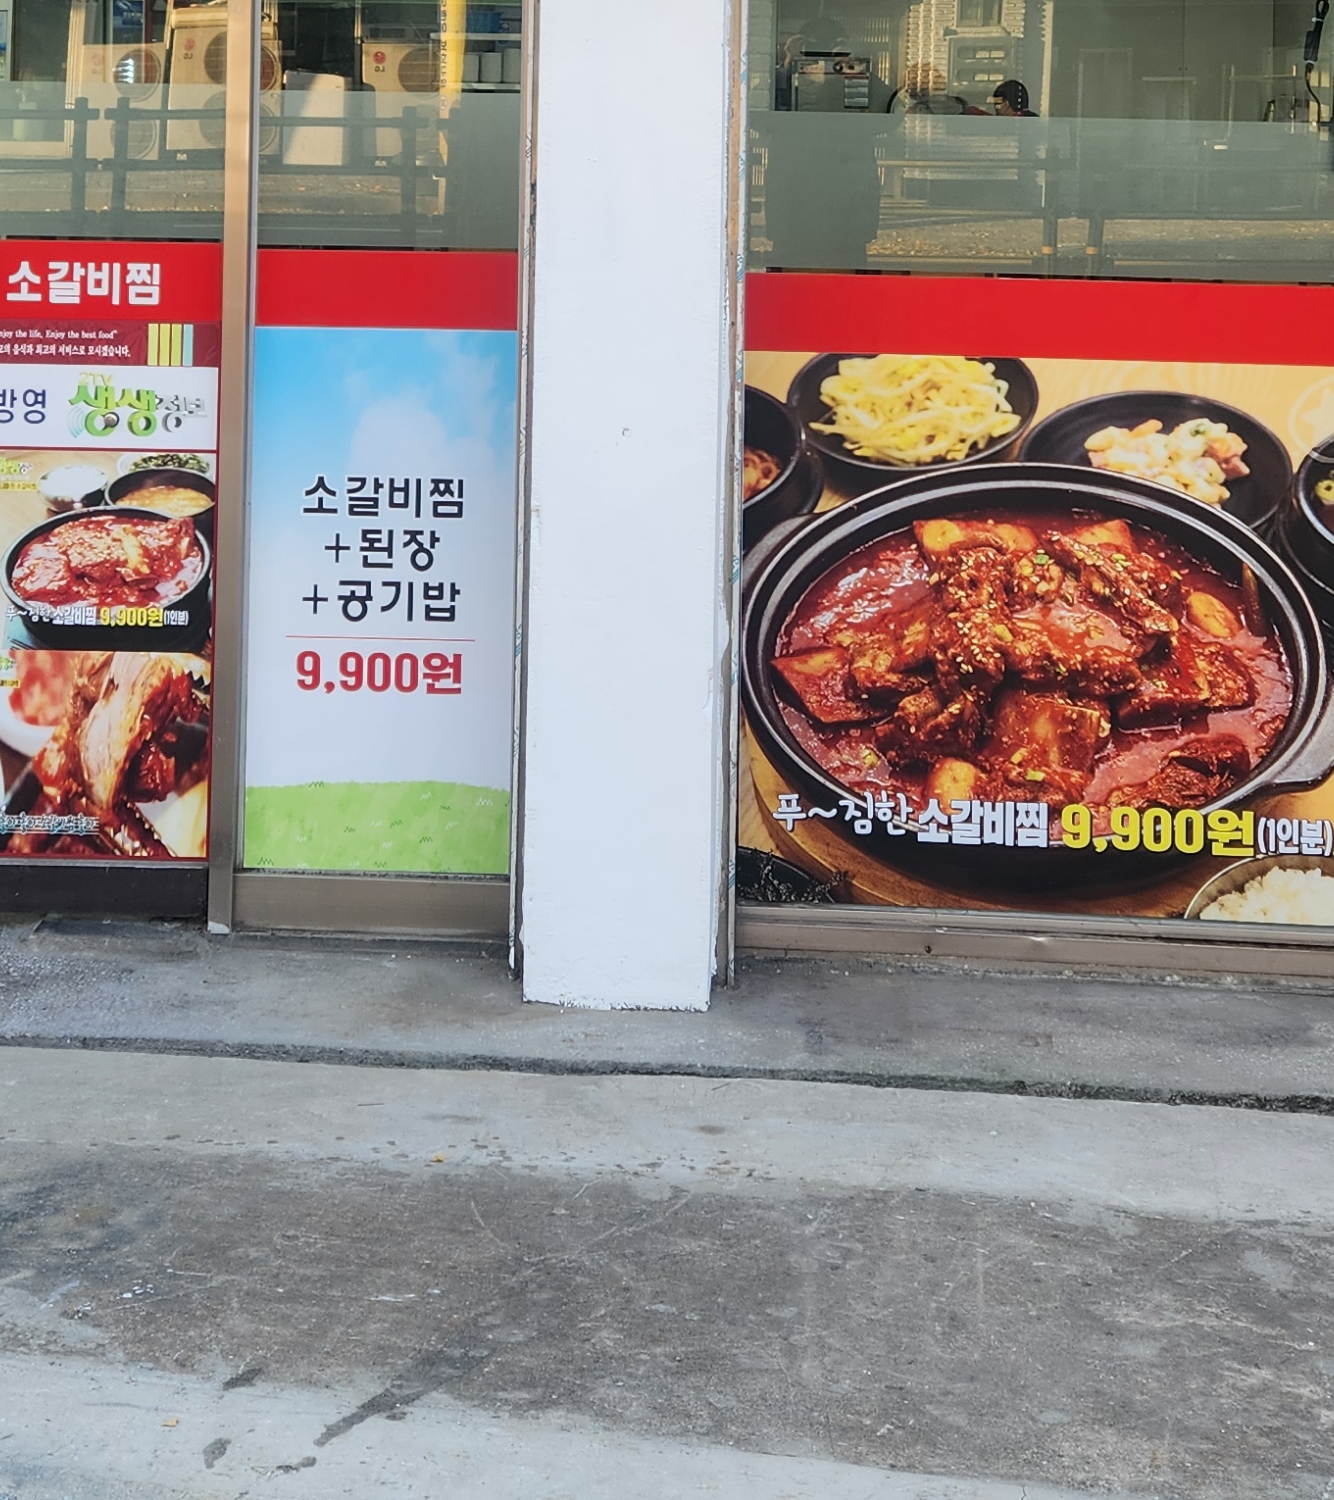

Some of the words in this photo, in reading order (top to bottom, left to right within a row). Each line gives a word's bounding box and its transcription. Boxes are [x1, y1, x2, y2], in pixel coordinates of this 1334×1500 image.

[6, 260, 162, 307] 소갈비찜
[15, 329, 28, 339] the
[45, 330, 66, 342] Enjoy
[68, 330, 80, 340] the
[81, 330, 97, 340] best
[302, 475, 465, 520] 소갈비찜
[324, 528, 441, 572] +된장
[52, 606, 98, 627] 소갈비찜
[99, 606, 164, 628] 9,900원
[302, 580, 461, 623] +공기밥
[295, 649, 463, 696] 9,900원
[916, 801, 1049, 848] 소갈비찜
[1061, 803, 1256, 856] 9,900원
[1257, 817, 1334, 857] (1인분)
